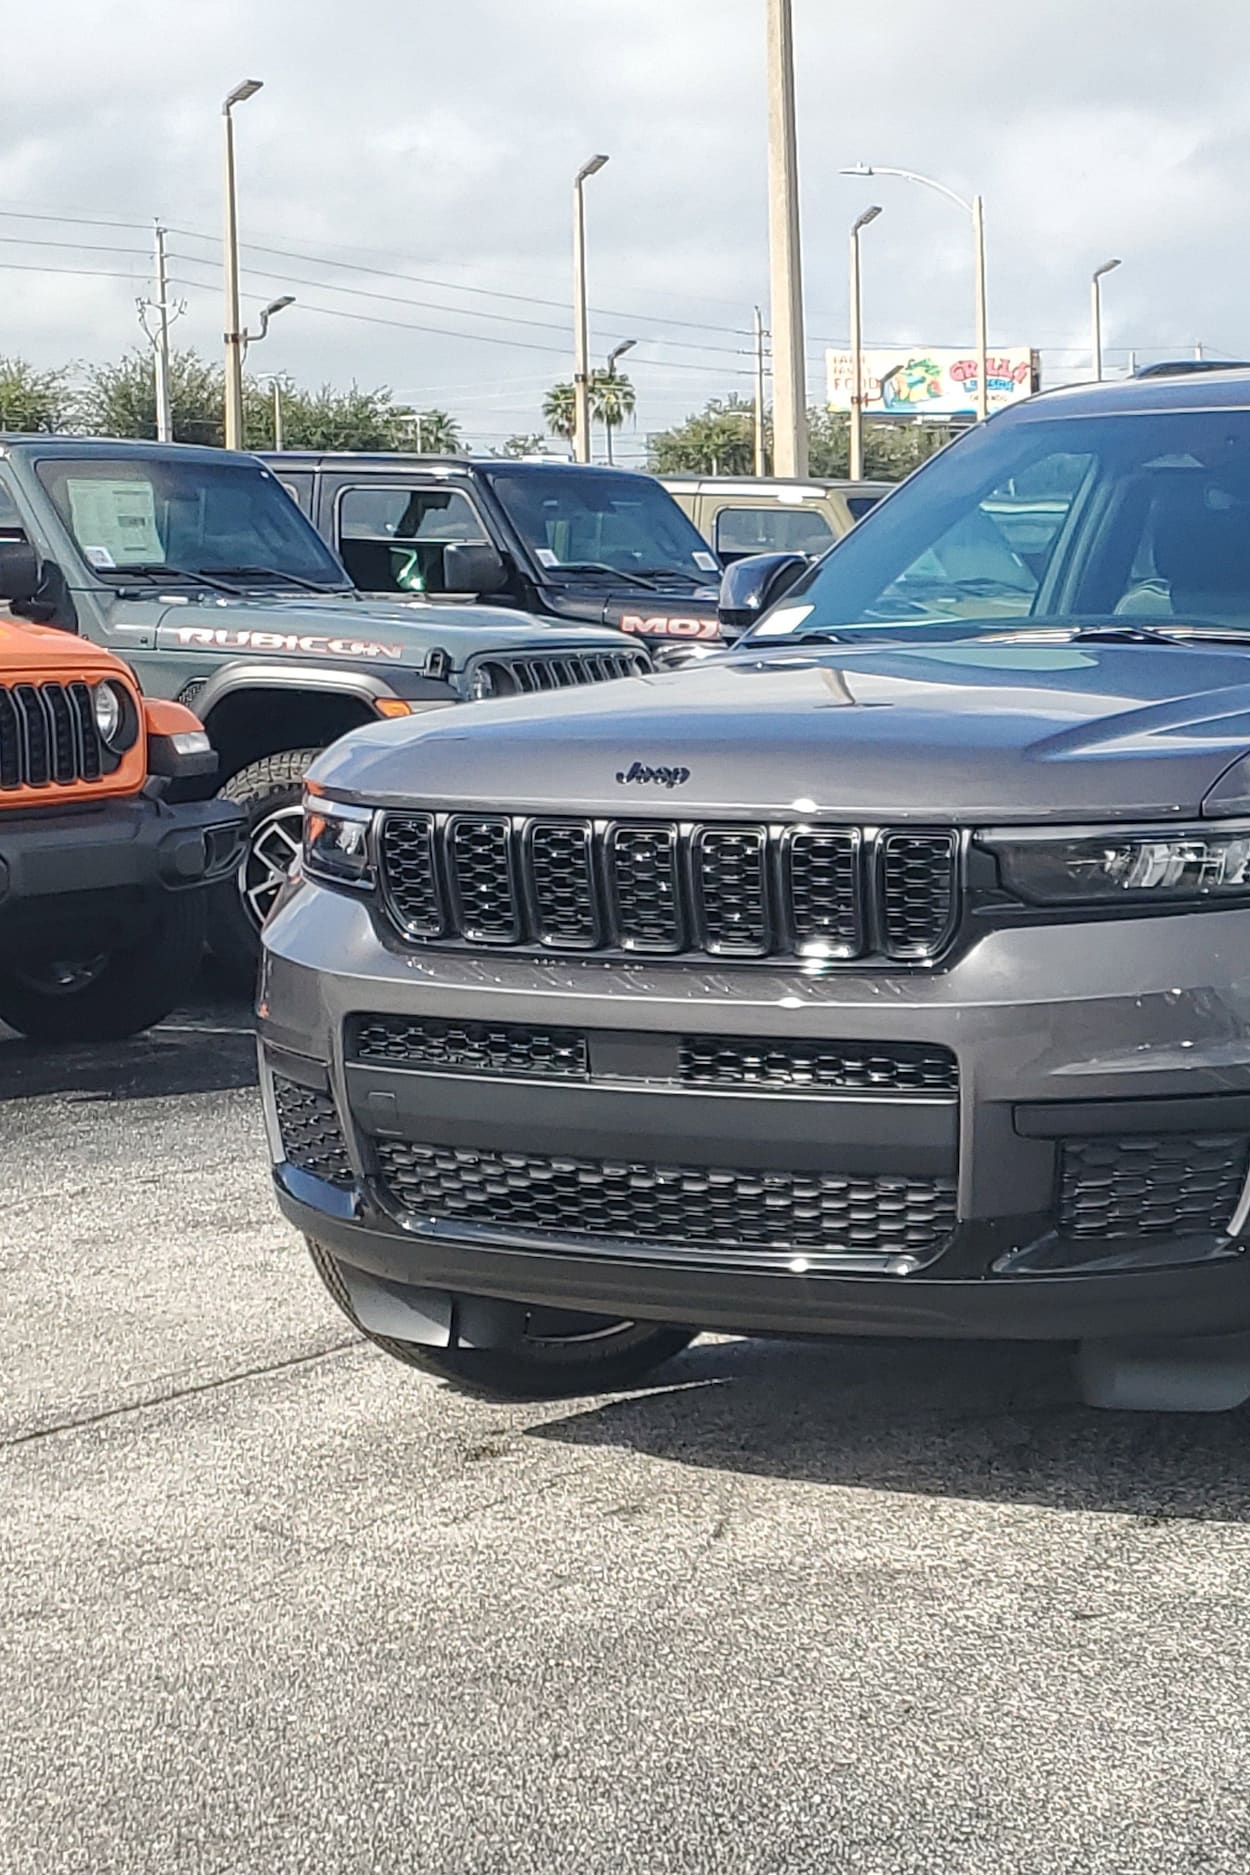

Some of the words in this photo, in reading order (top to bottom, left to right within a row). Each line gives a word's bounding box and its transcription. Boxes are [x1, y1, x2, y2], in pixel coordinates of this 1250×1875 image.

[949, 357, 1031, 384] GRLLS
[177, 626, 404, 659] RUBICON
[616, 762, 690, 789] Jeep
